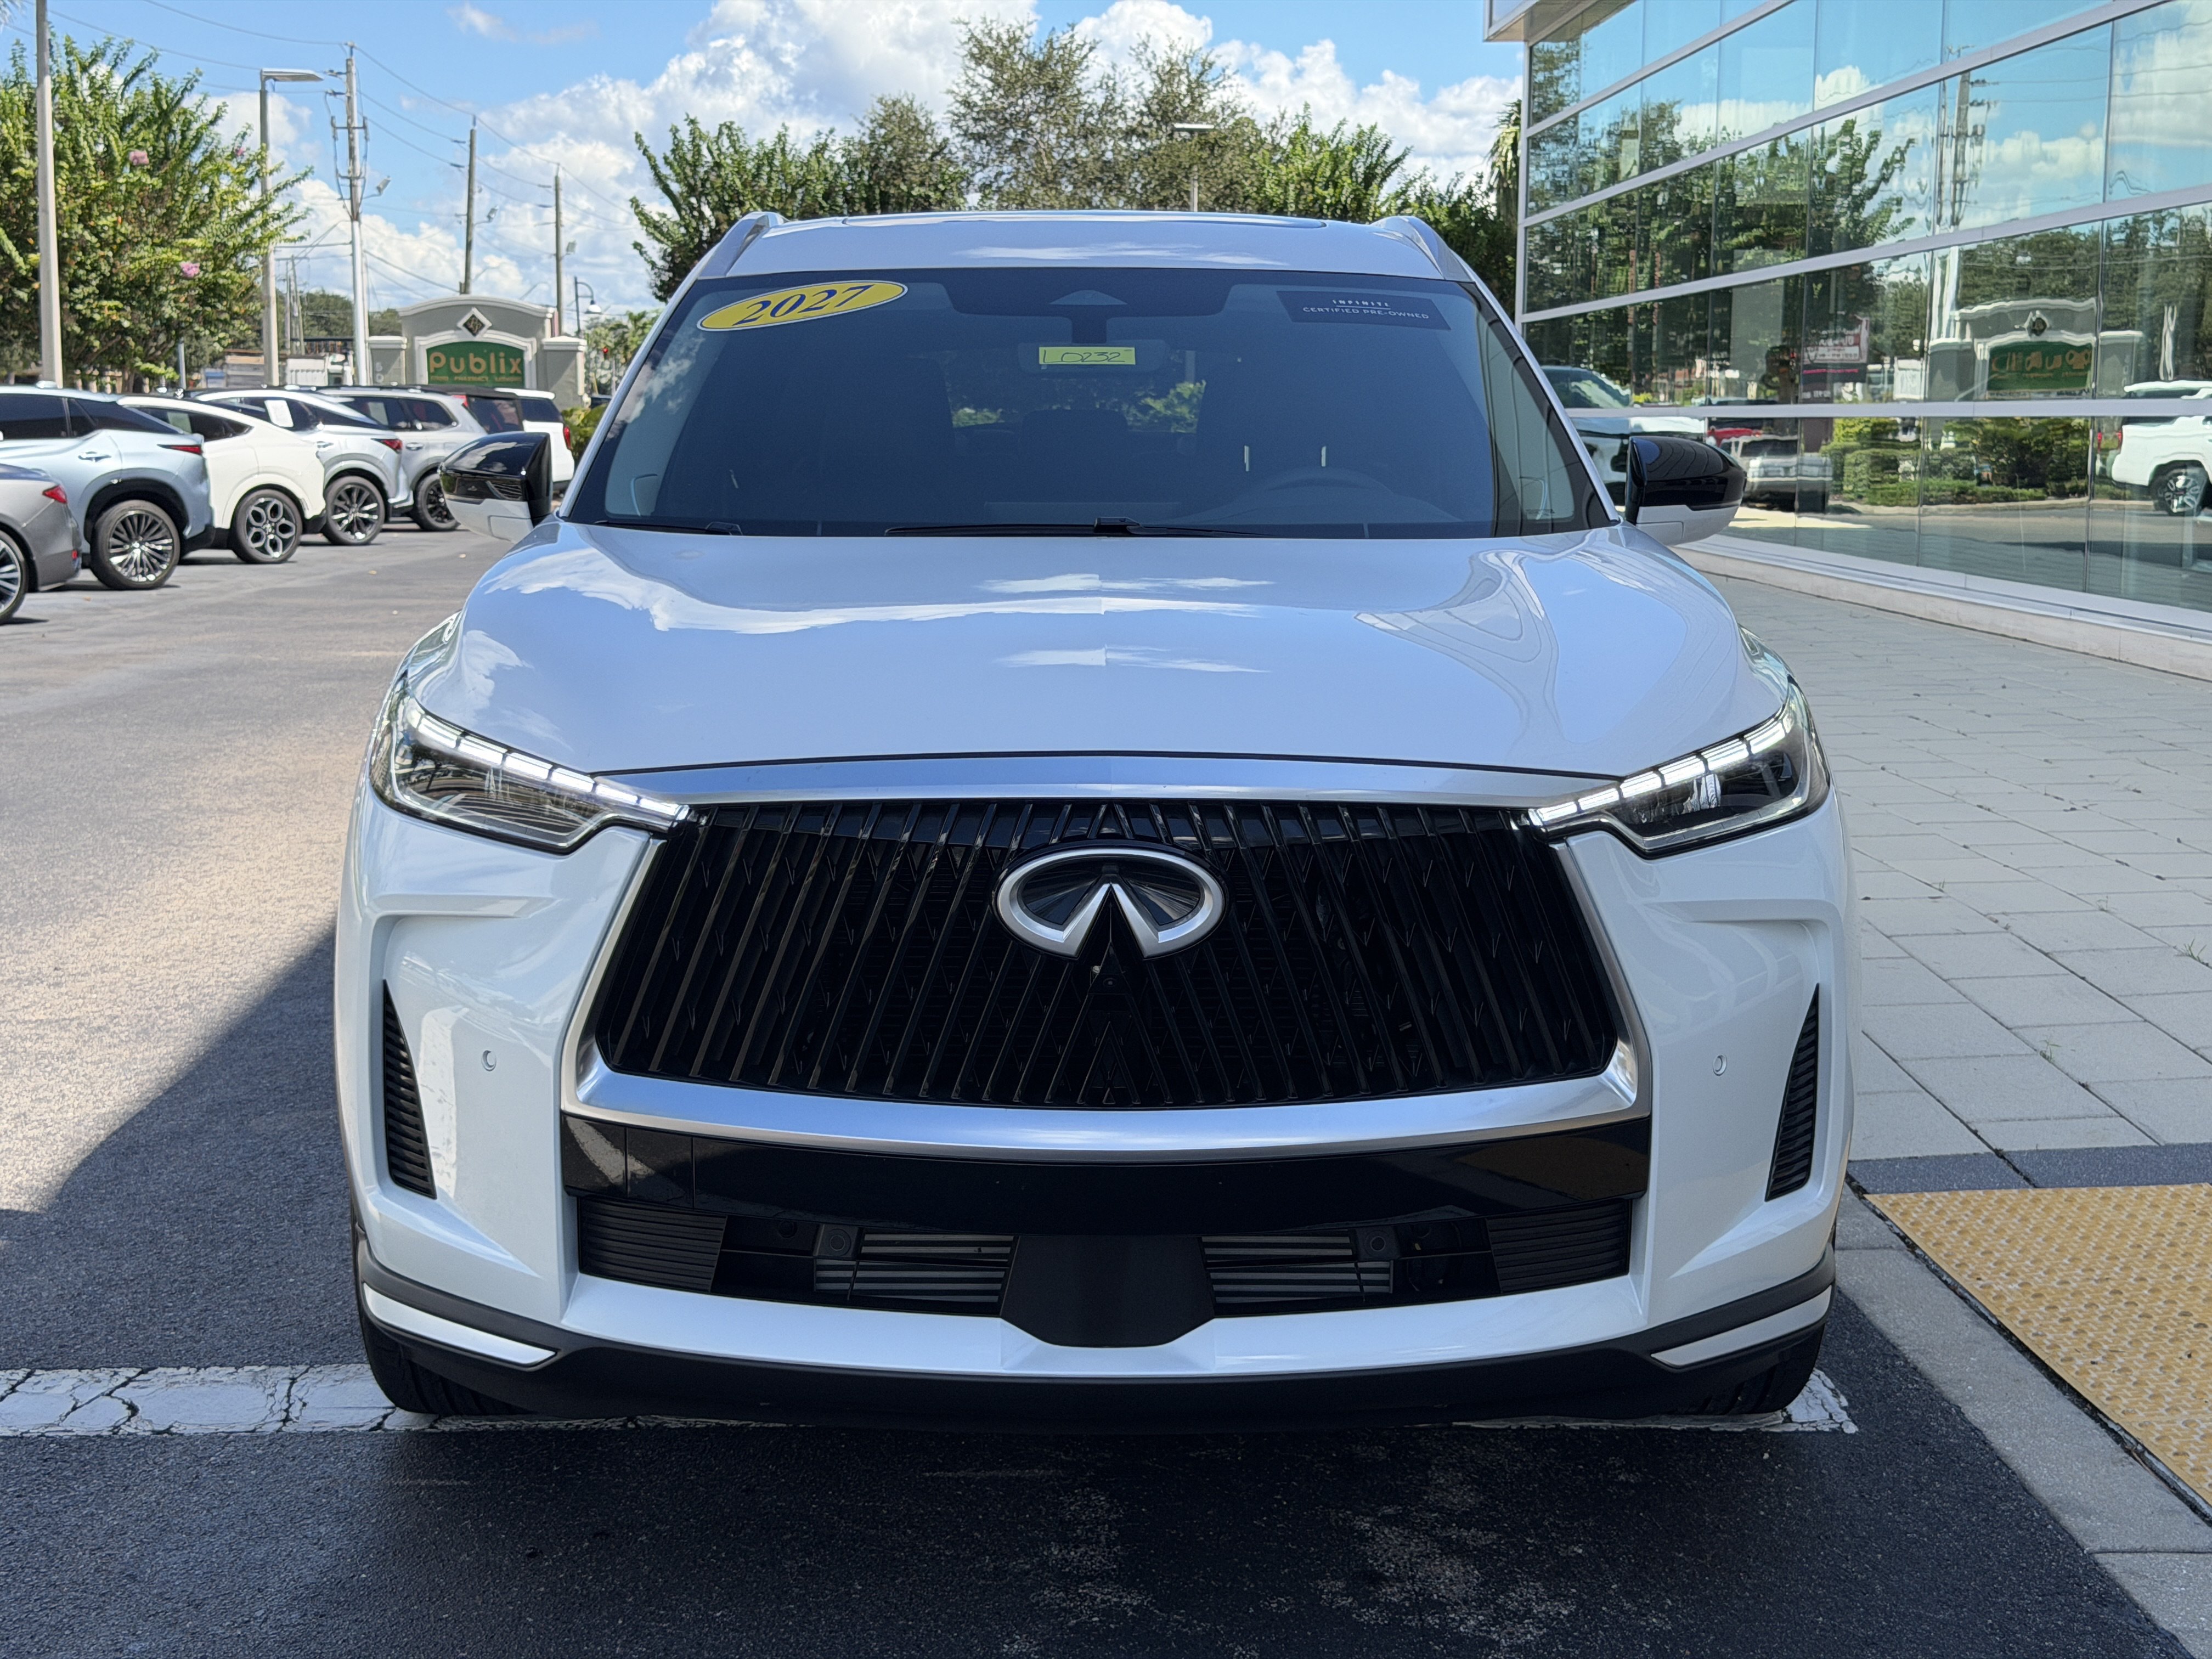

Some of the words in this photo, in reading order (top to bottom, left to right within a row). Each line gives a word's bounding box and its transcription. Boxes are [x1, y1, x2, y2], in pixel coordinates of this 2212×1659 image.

[732, 284, 876, 326] 2027
[1332, 300, 1390, 308] INFINITI
[1363, 309, 1429, 319] PRE-OWNED
[430, 352, 522, 374] Publix
